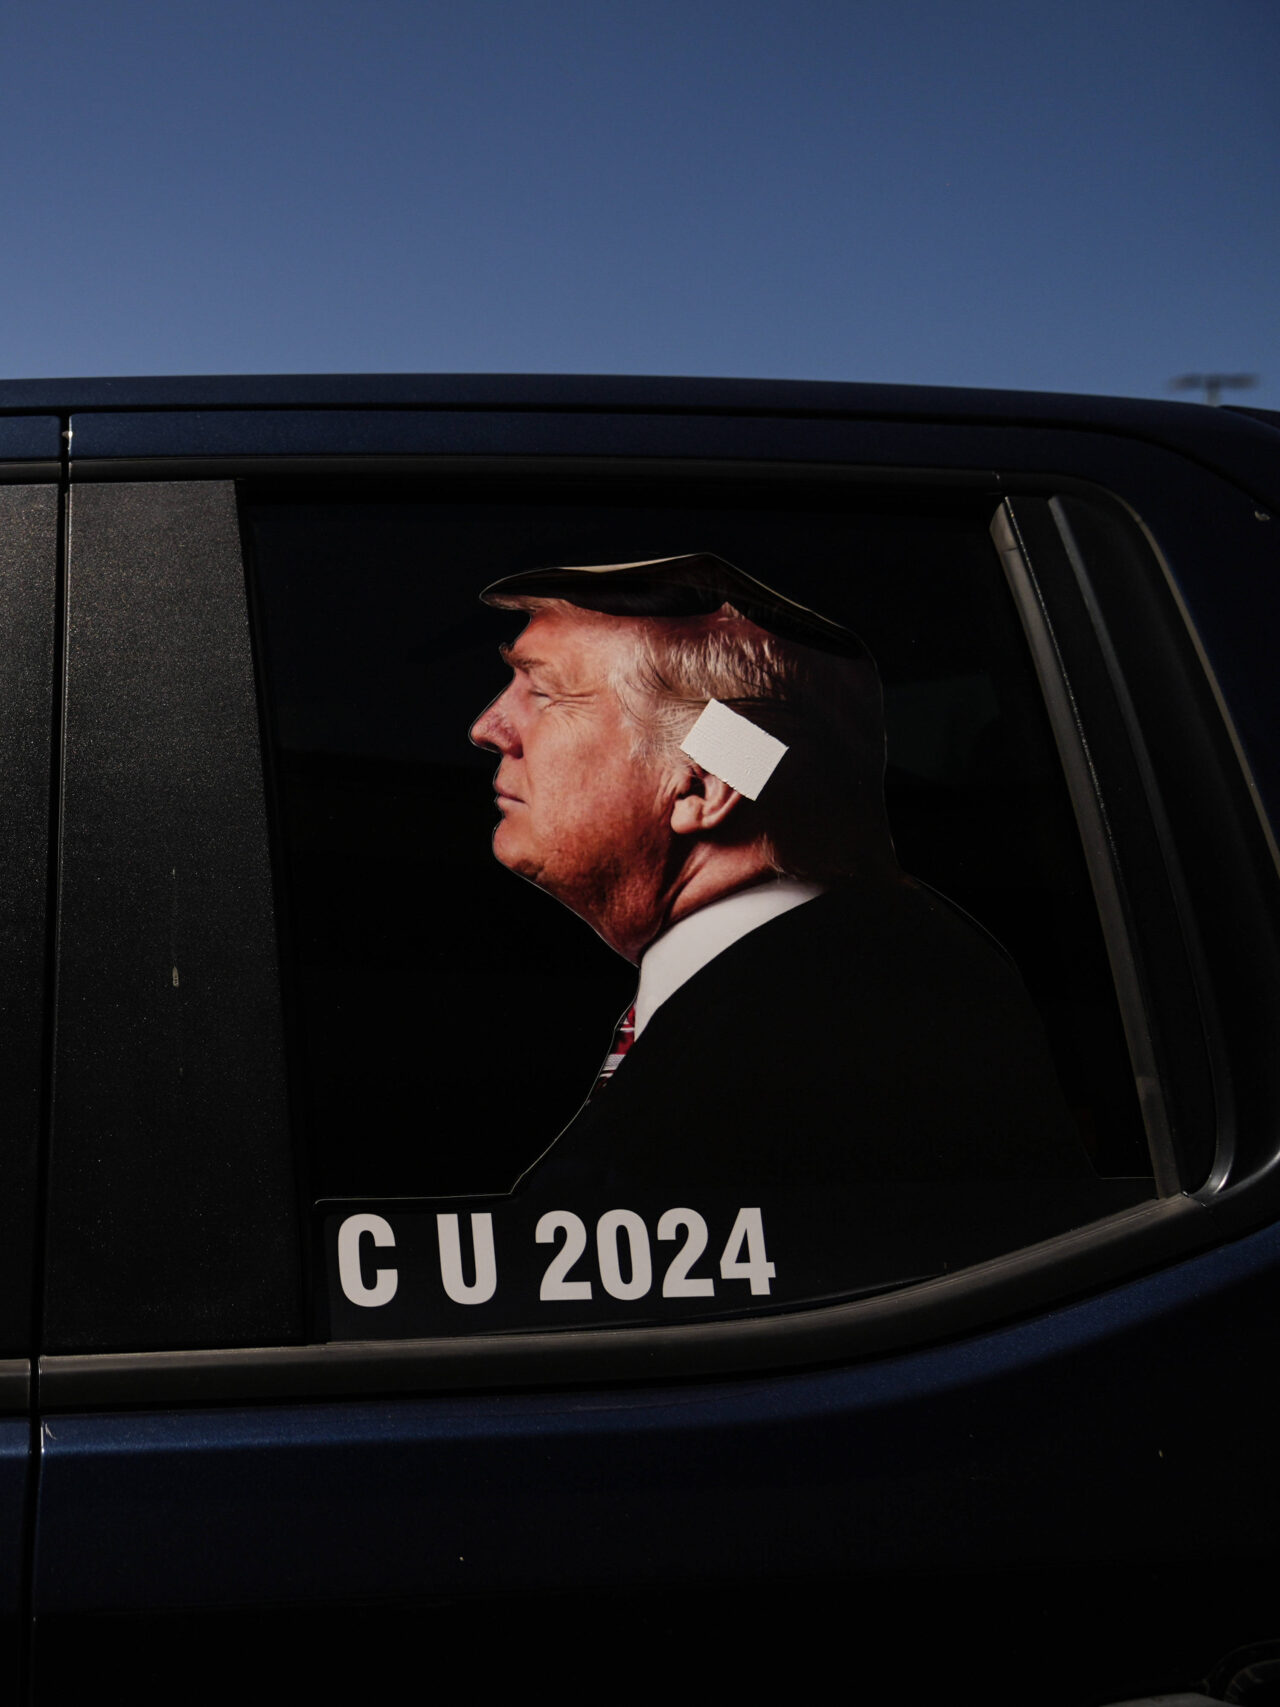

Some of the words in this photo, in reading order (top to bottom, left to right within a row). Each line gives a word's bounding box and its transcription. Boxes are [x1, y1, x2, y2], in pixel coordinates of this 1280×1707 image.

[337, 1213, 399, 1308] C
[436, 1212, 497, 1305] U
[535, 1207, 777, 1301] 2024
